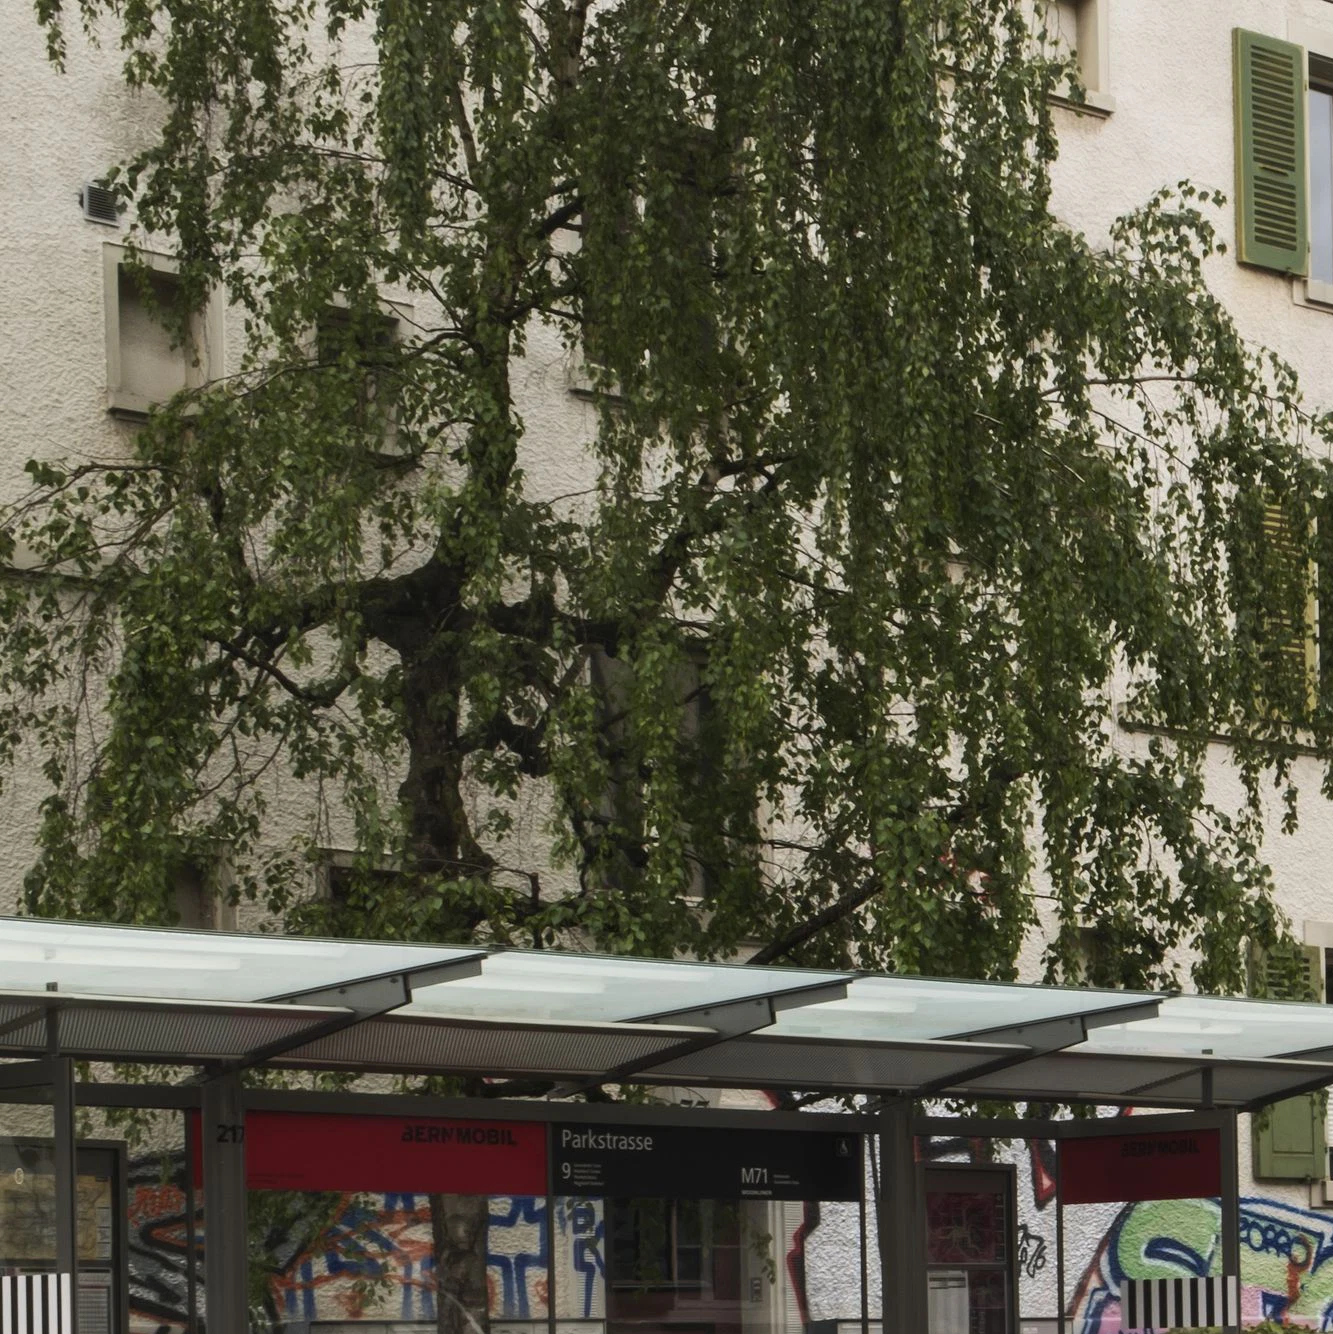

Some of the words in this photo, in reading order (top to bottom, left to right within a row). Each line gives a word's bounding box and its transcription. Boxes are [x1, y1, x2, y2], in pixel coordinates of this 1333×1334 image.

[562, 1129, 653, 1151] Parkstrasse
[561, 1162, 571, 1179] 9
[741, 1168, 768, 1184] M71
